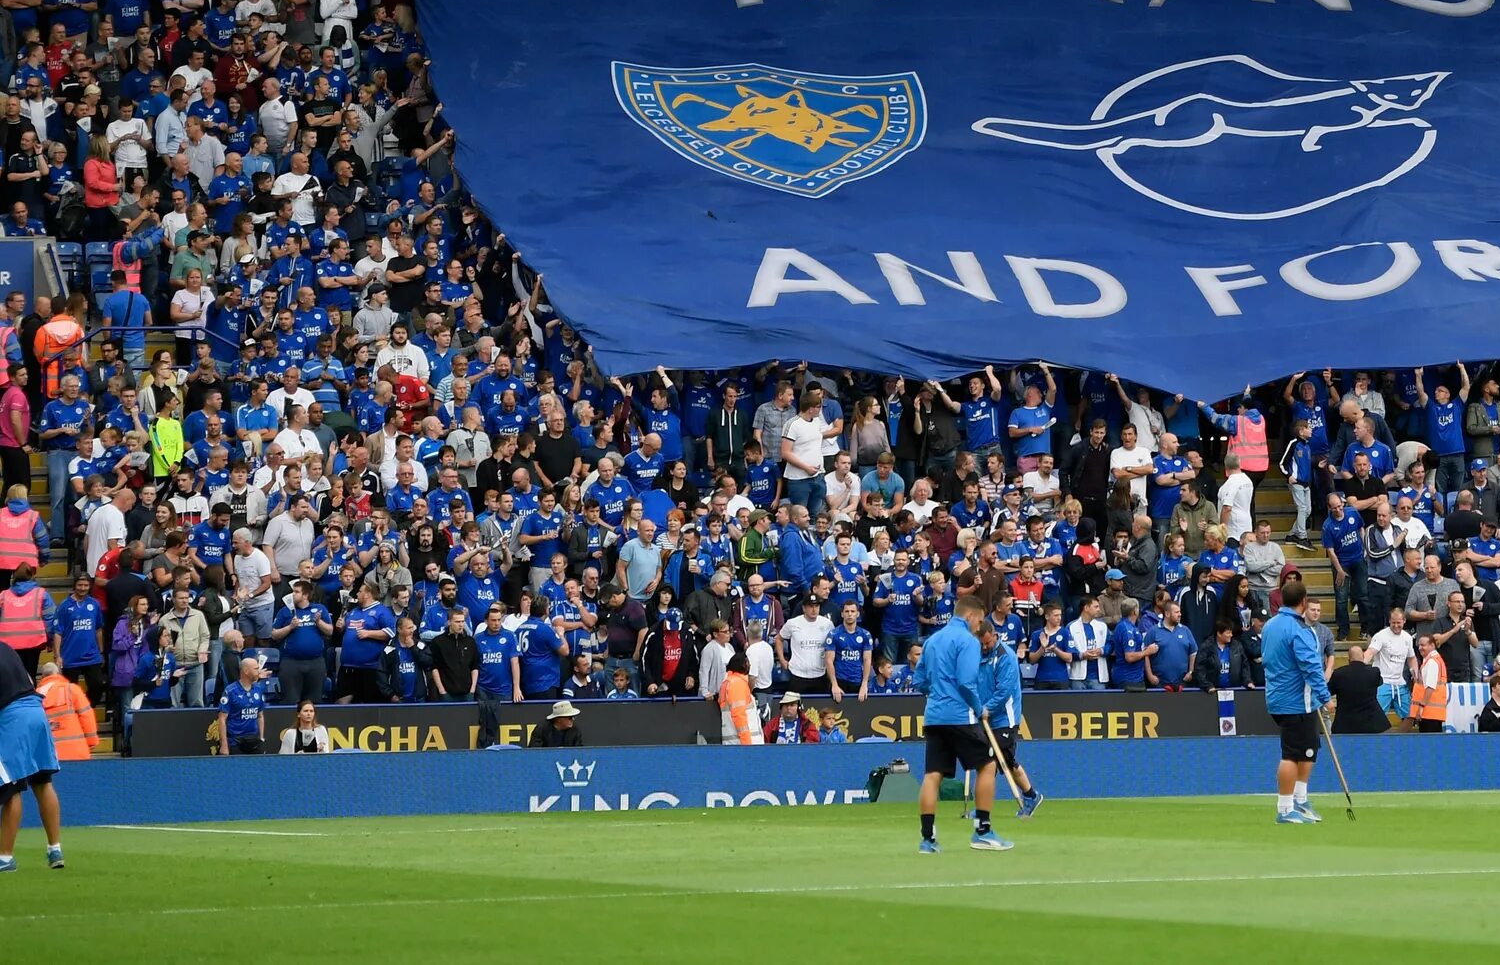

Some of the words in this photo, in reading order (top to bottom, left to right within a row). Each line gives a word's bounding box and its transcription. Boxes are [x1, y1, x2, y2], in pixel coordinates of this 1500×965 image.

[631, 81, 726, 160] LEICESTER
[733, 161, 801, 186] CITY
[815, 138, 902, 182] FOOTBALL
[886, 94, 908, 134] CLUB
[746, 247, 1128, 319] AND
[1051, 711, 1160, 739] BEER
